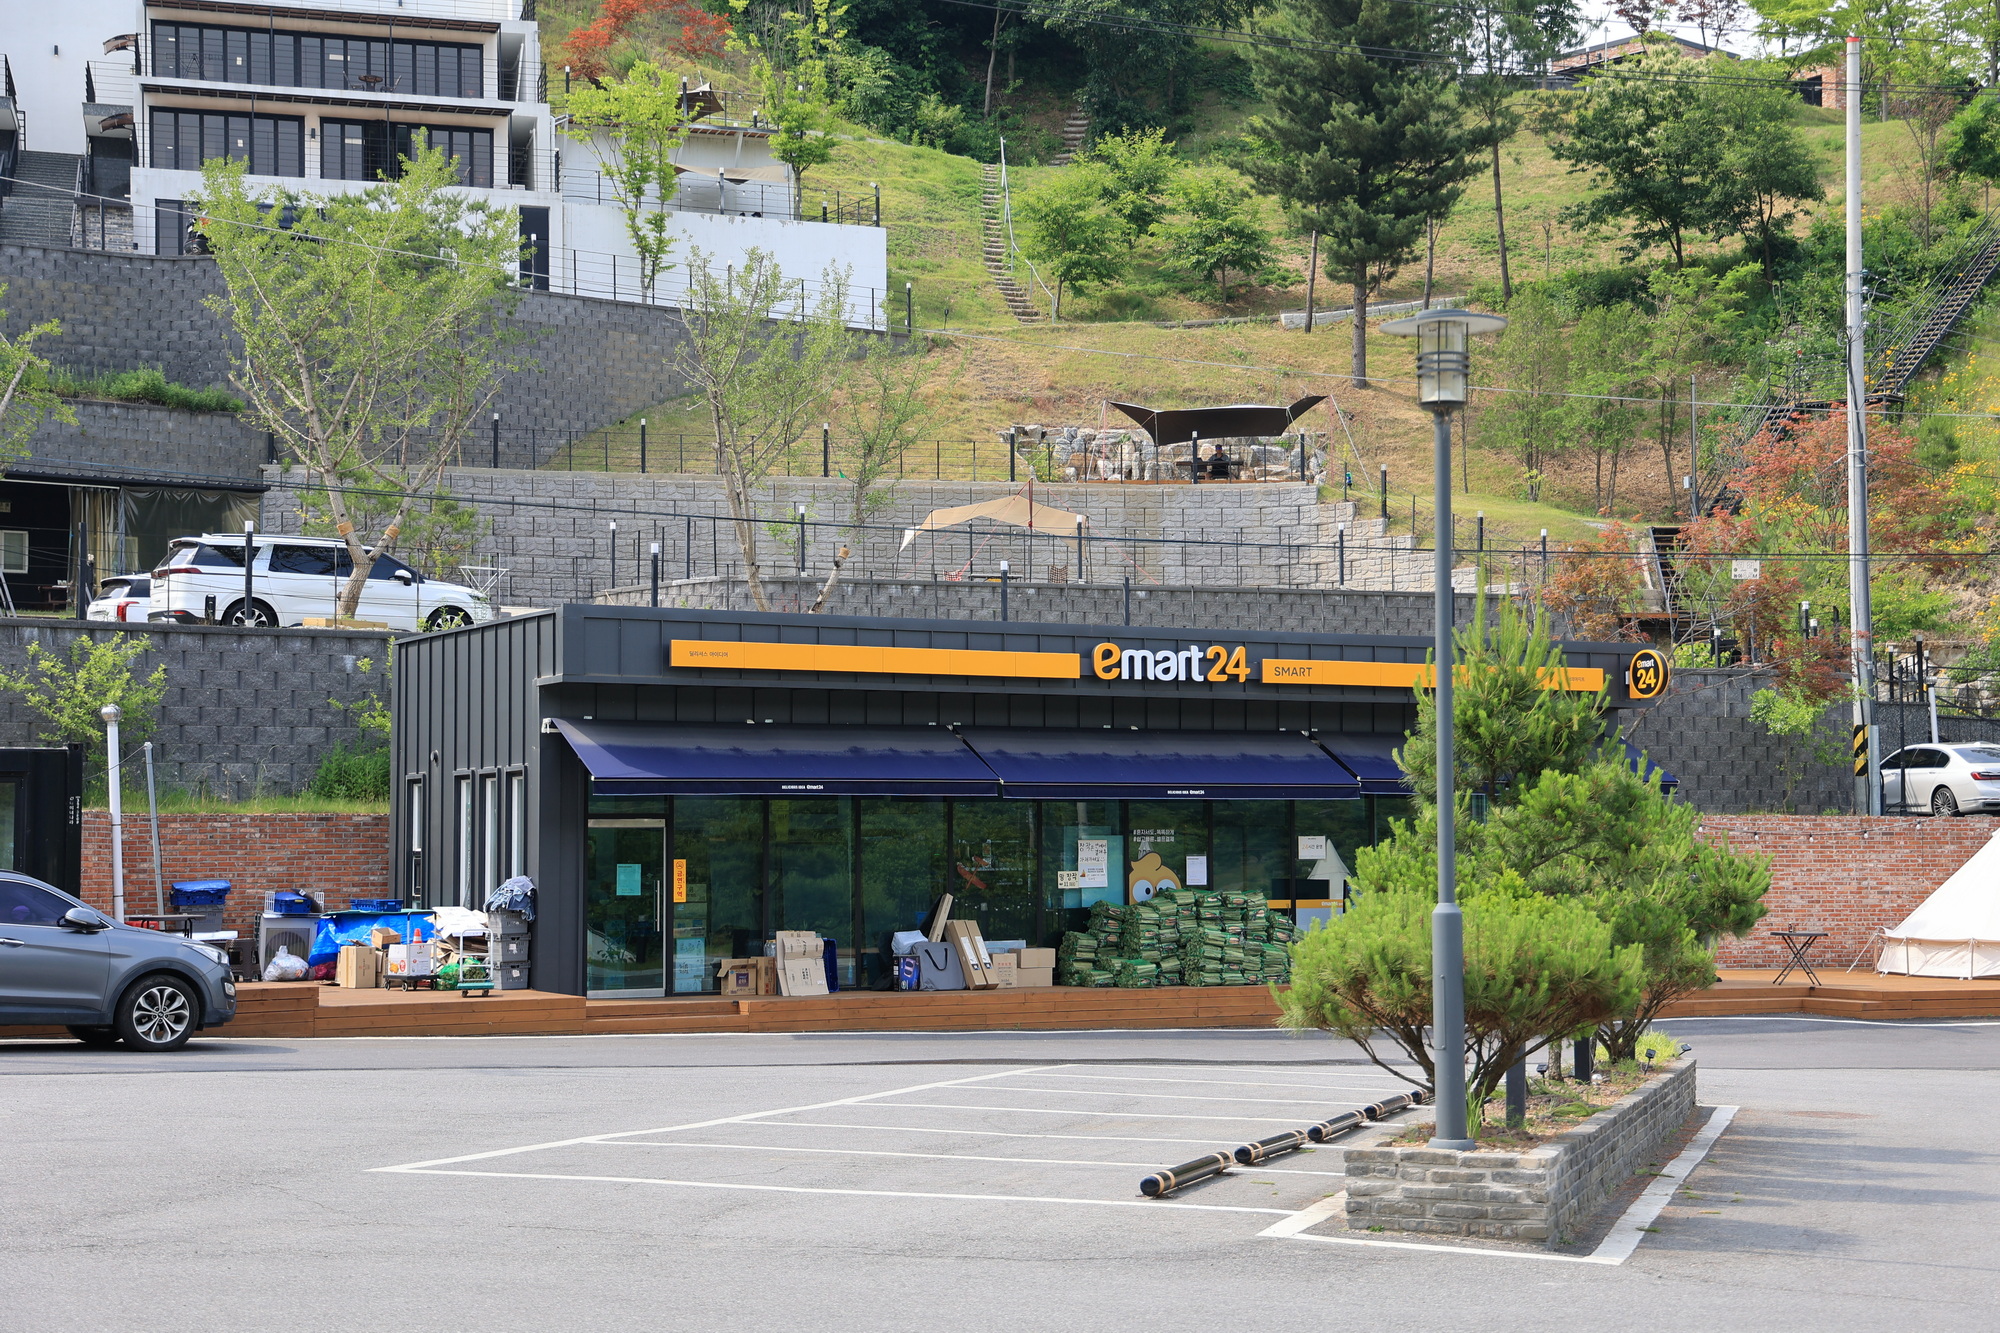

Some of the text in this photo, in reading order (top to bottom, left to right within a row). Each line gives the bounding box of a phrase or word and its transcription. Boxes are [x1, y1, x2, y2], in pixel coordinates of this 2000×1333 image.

[1093, 642, 1250, 682] emart24
[1637, 659, 1654, 668] emart
[1274, 666, 1312, 677] SMART
[1637, 668, 1656, 688] 24
